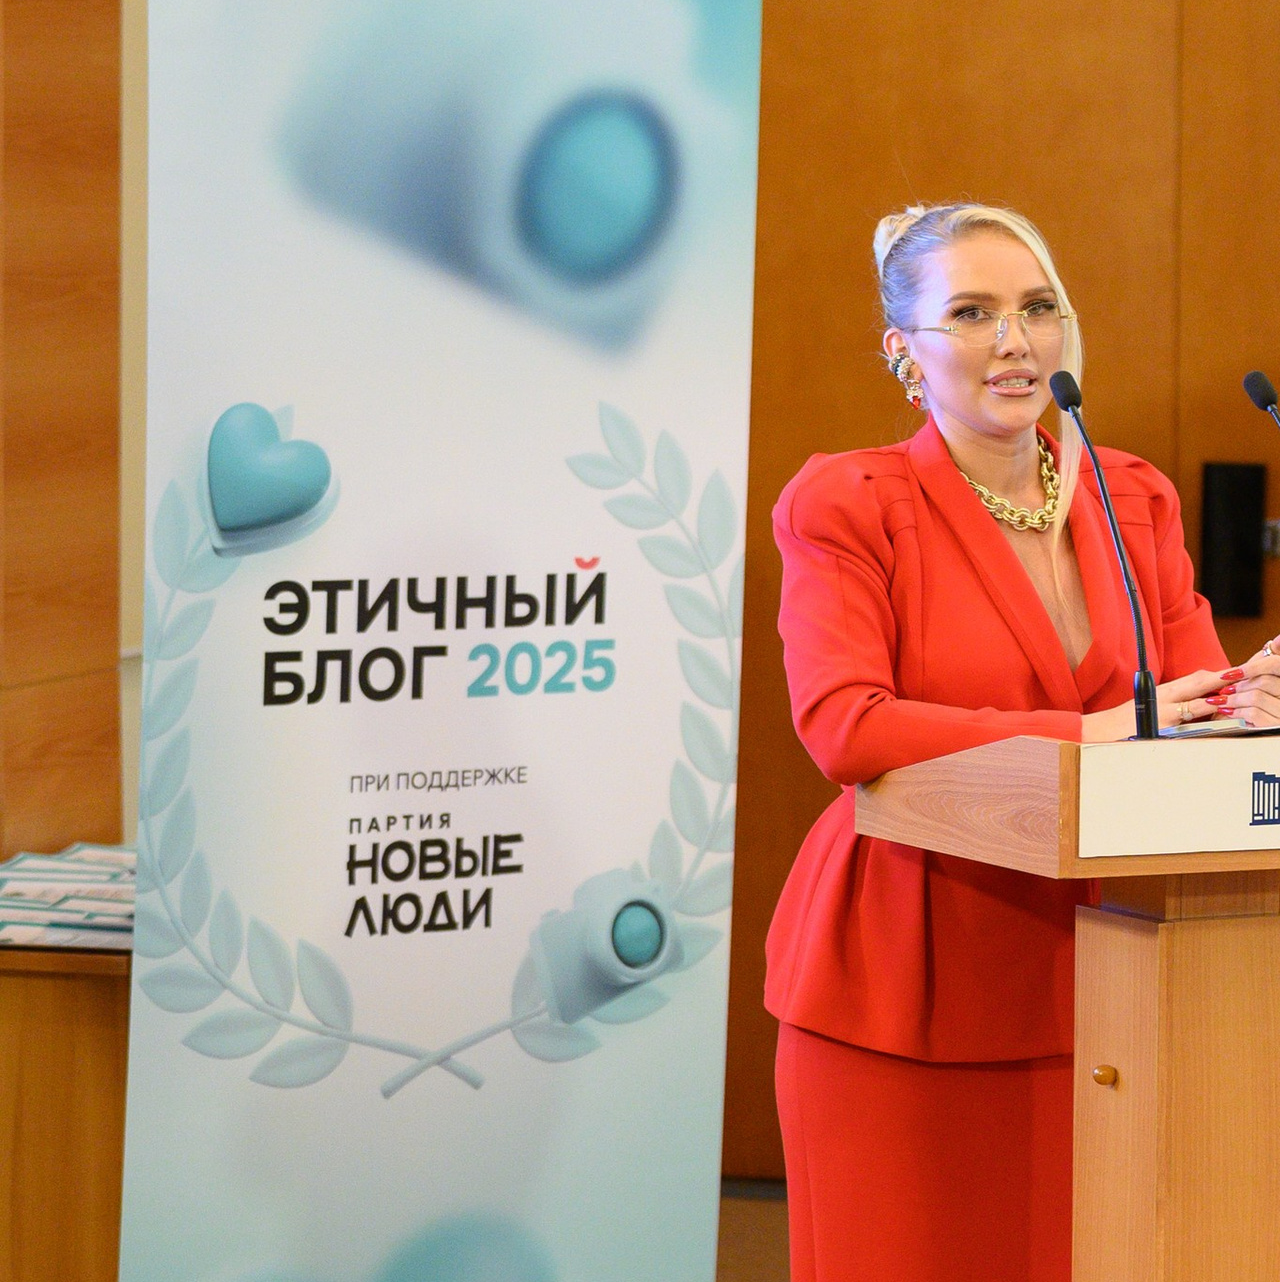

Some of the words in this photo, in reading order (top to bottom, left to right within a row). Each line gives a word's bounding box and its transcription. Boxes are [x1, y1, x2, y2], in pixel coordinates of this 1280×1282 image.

[263, 556, 608, 636] ЭТИЧНЫЙ
[262, 646, 448, 707] БЛОГ
[466, 638, 617, 700] 2025
[349, 773, 391, 794] ПРИ
[396, 766, 528, 793] ПОДДЕРЖКЕ
[349, 812, 452, 835] ПАРТИЯ
[346, 833, 525, 886] НОВЫЕ
[344, 887, 493, 938] ЛЮДИ
